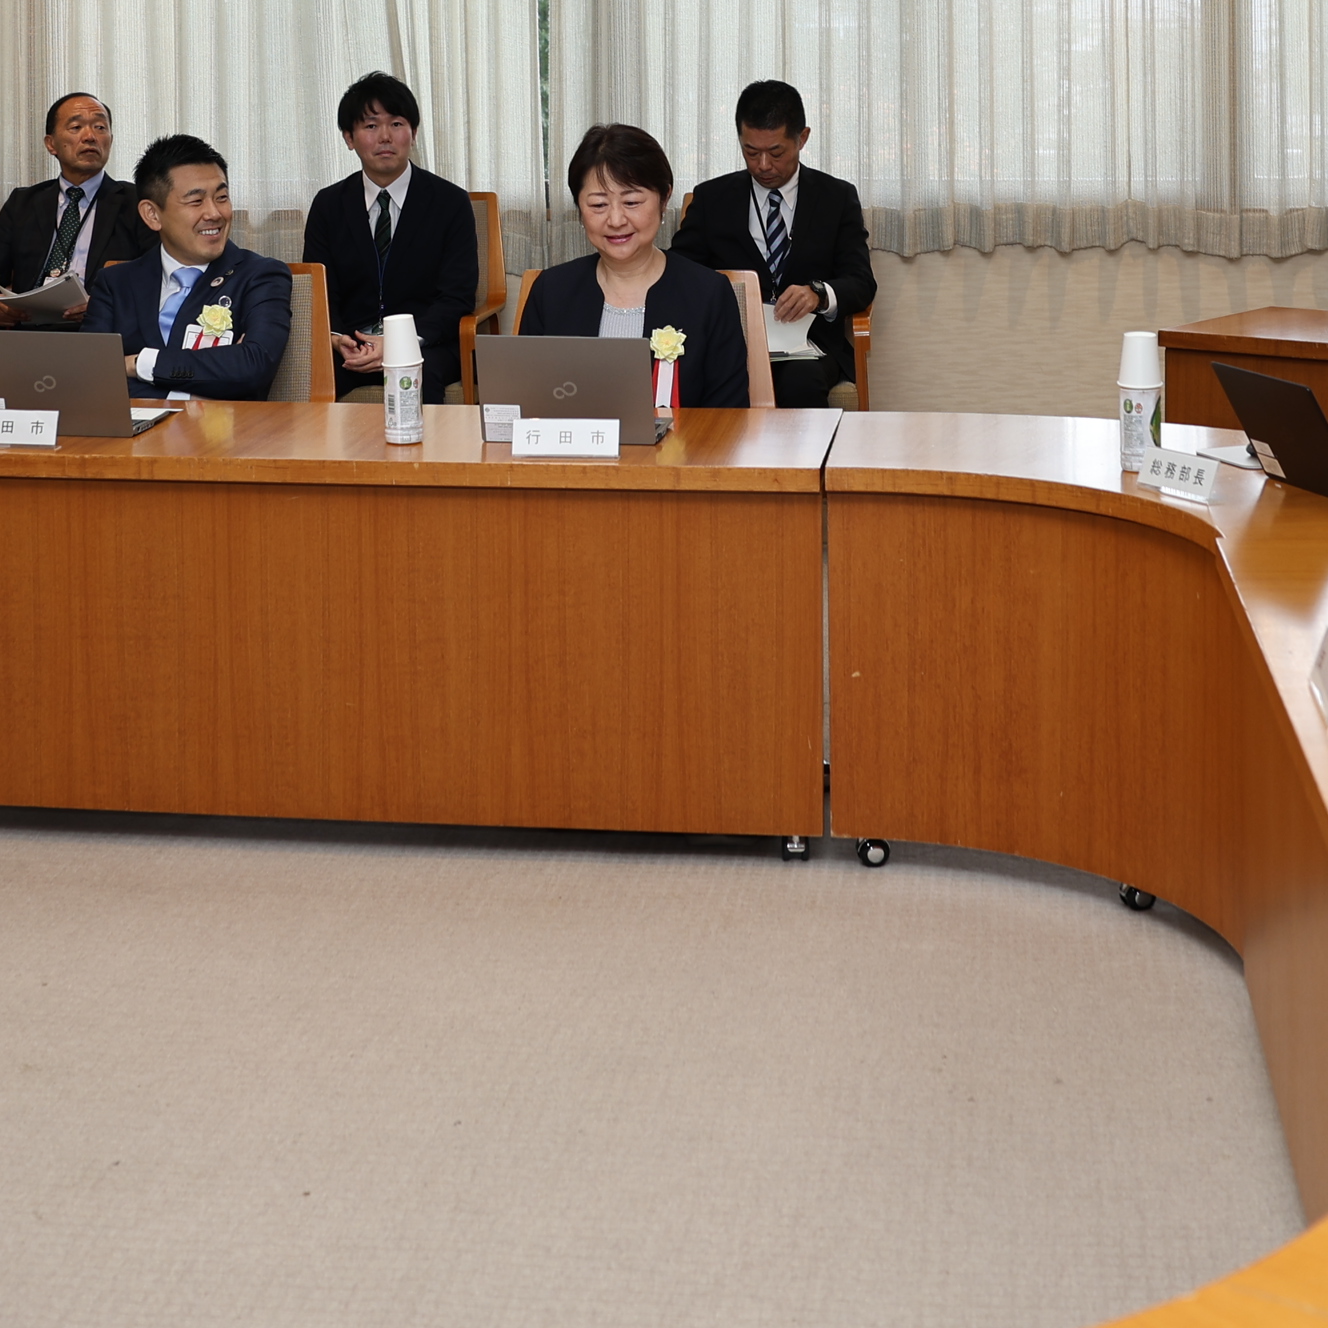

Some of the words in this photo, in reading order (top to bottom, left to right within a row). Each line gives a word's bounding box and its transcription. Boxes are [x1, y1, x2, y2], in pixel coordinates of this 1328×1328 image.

[525, 430, 605, 445] 行田市
[1150, 459, 1205, 486] 総務部長
